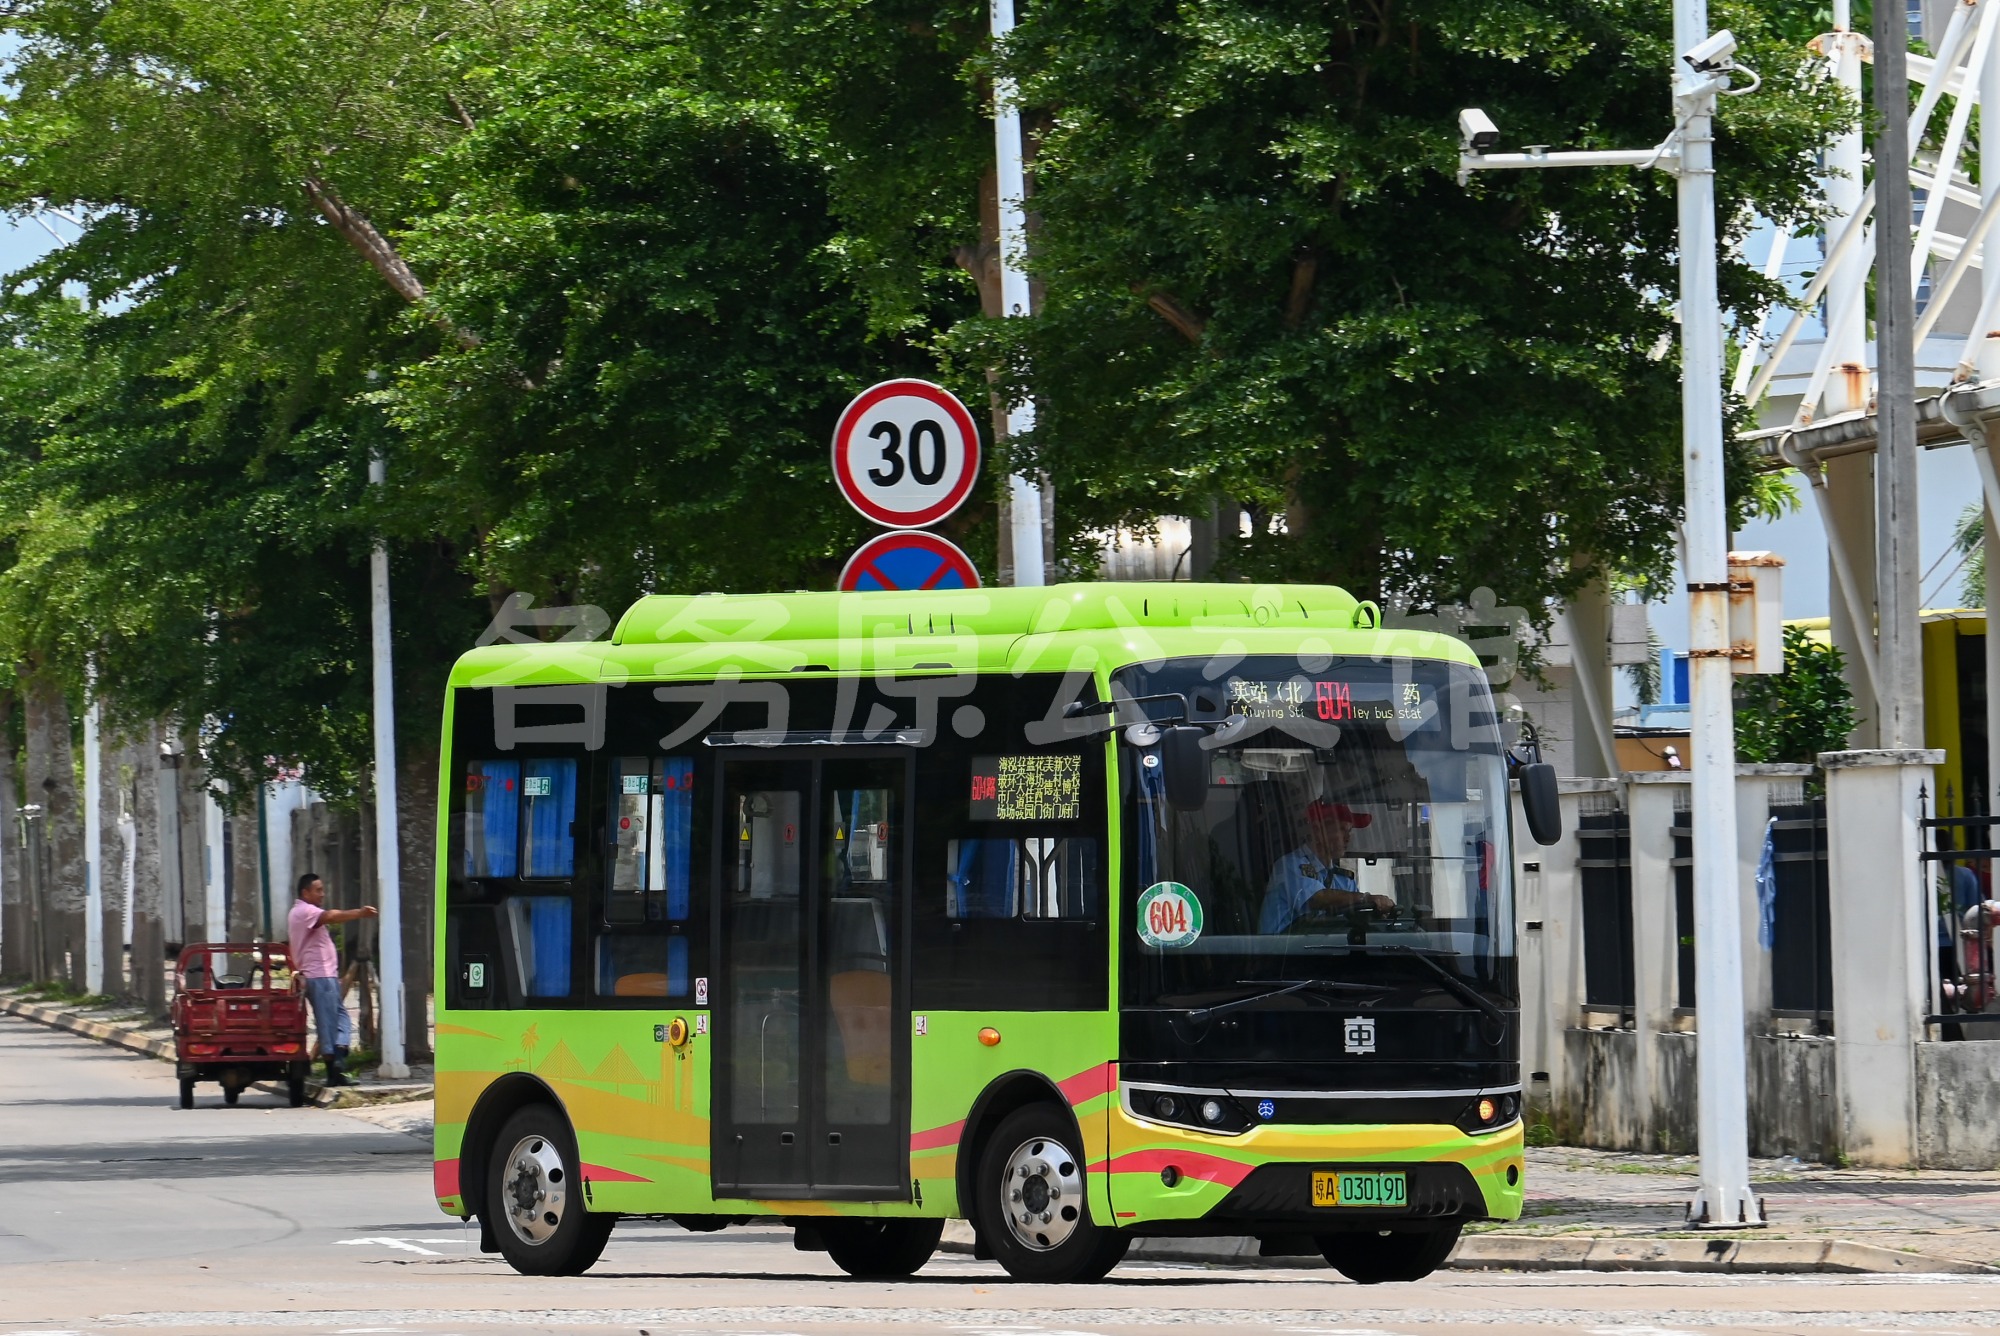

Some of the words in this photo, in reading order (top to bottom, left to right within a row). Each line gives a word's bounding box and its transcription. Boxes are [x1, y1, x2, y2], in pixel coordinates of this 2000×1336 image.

[868, 419, 946, 487] 30
[1316, 681, 1352, 720] 604
[1375, 706, 1393, 719] bus
[1399, 708, 1422, 719] stat
[1150, 899, 1187, 934] 604
